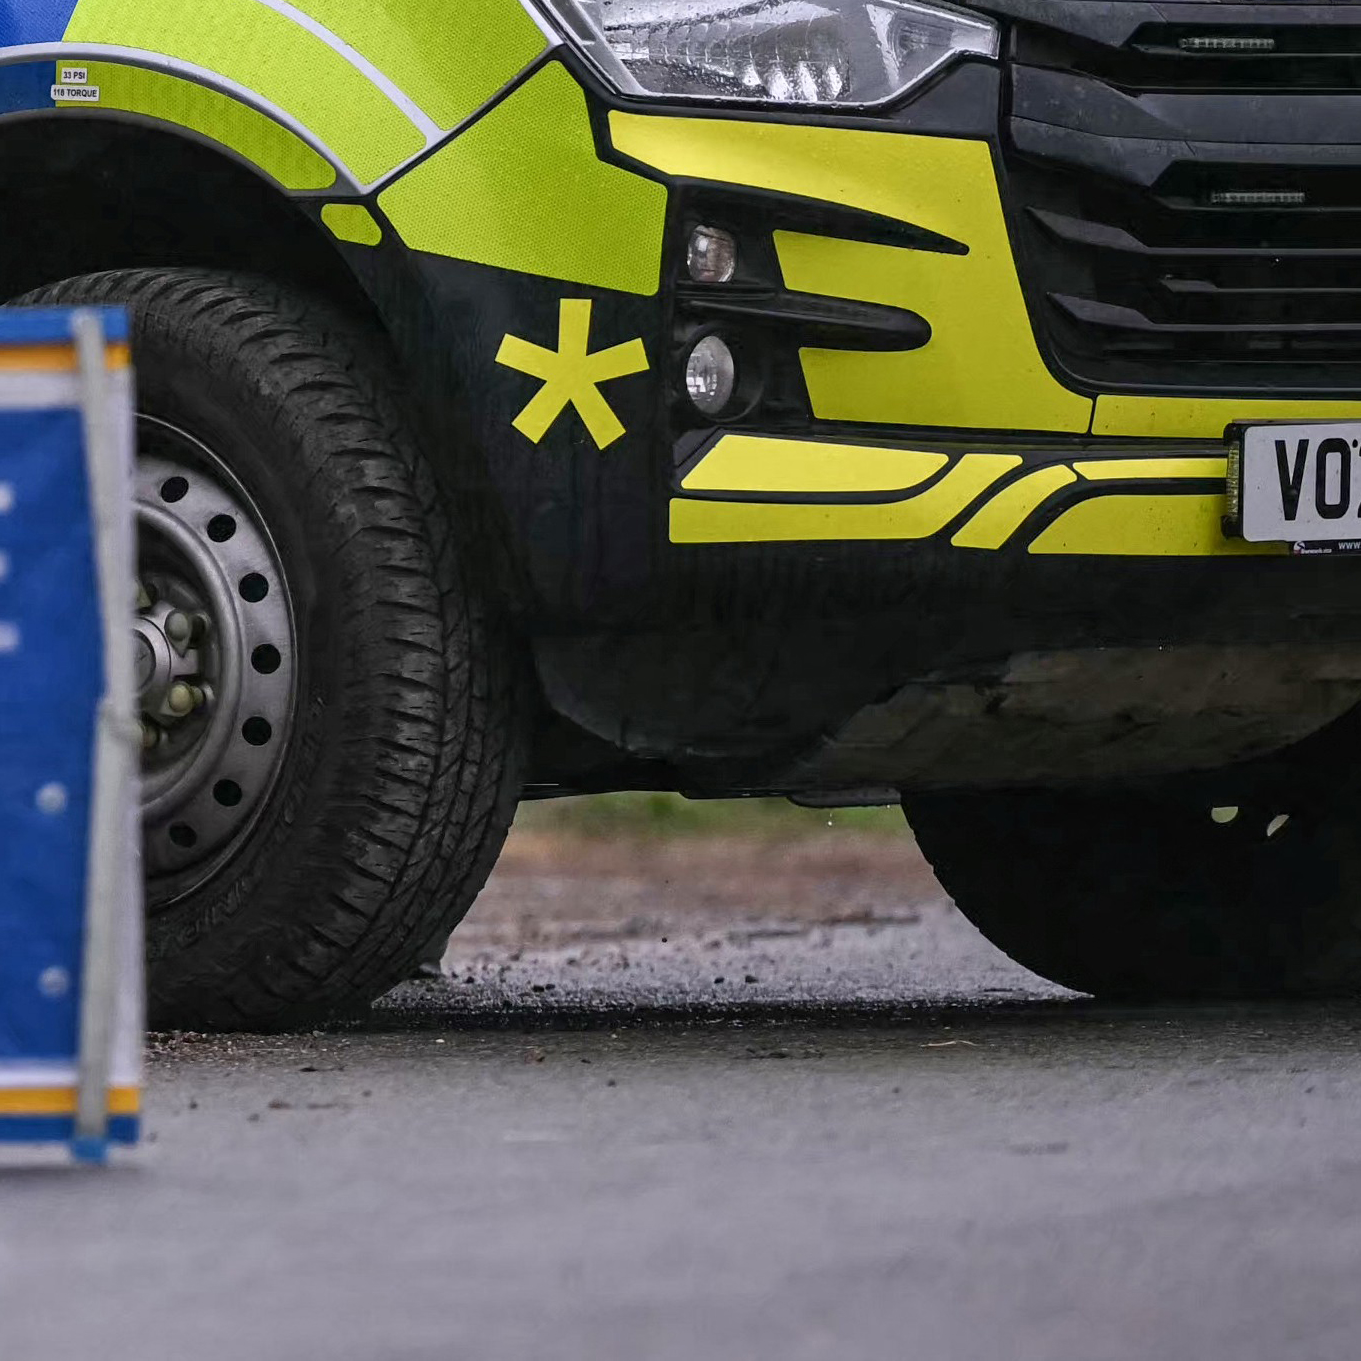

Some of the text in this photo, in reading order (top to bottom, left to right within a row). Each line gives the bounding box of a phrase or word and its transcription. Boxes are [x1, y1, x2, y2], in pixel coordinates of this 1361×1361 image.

[63, 71, 86, 80] 33 PSI
[67, 88, 98, 98] TORQUE
[1274, 437, 1361, 521] VO
